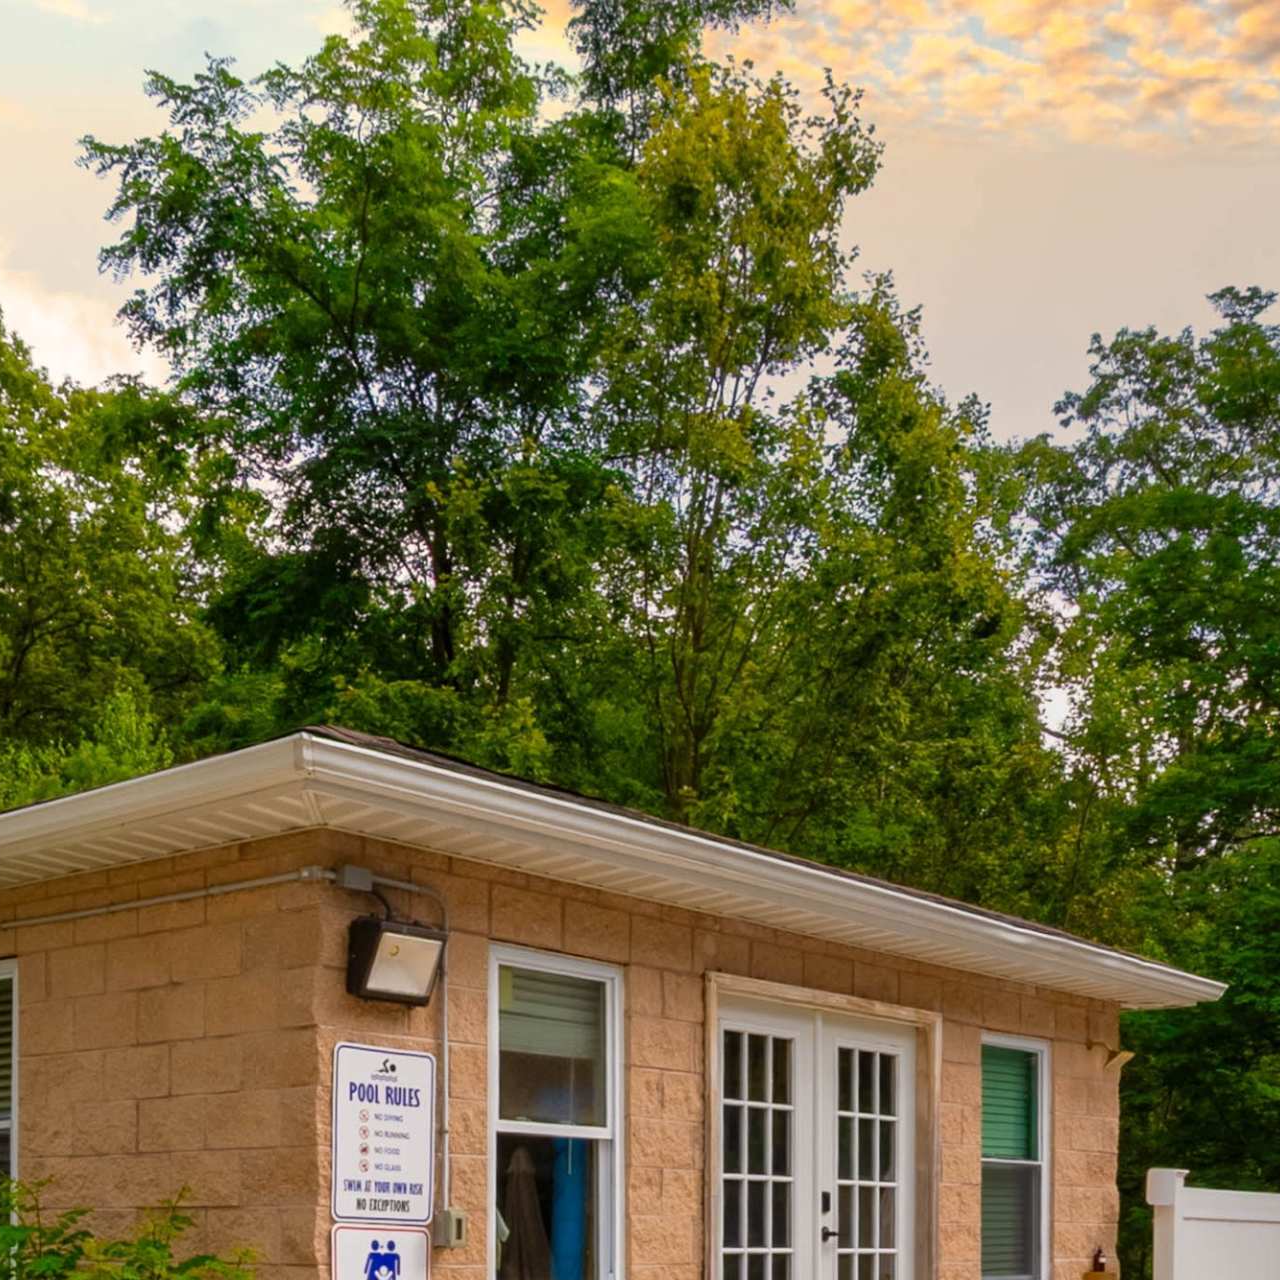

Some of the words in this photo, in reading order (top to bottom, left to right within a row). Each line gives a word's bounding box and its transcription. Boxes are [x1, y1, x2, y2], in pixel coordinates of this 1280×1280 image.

[349, 1081, 380, 1104] POOL
[385, 1086, 420, 1107] RULES
[374, 1113, 383, 1121] NO
[374, 1130, 383, 1138] NO
[344, 1179, 362, 1192] SWIM
[364, 1180, 371, 1193] AT
[374, 1181, 391, 1194] YOUR
[393, 1182, 407, 1195] OWN
[409, 1183, 423, 1196] RISK
[356, 1198, 366, 1210] NO
[369, 1199, 410, 1213] EXCEPTIONS
